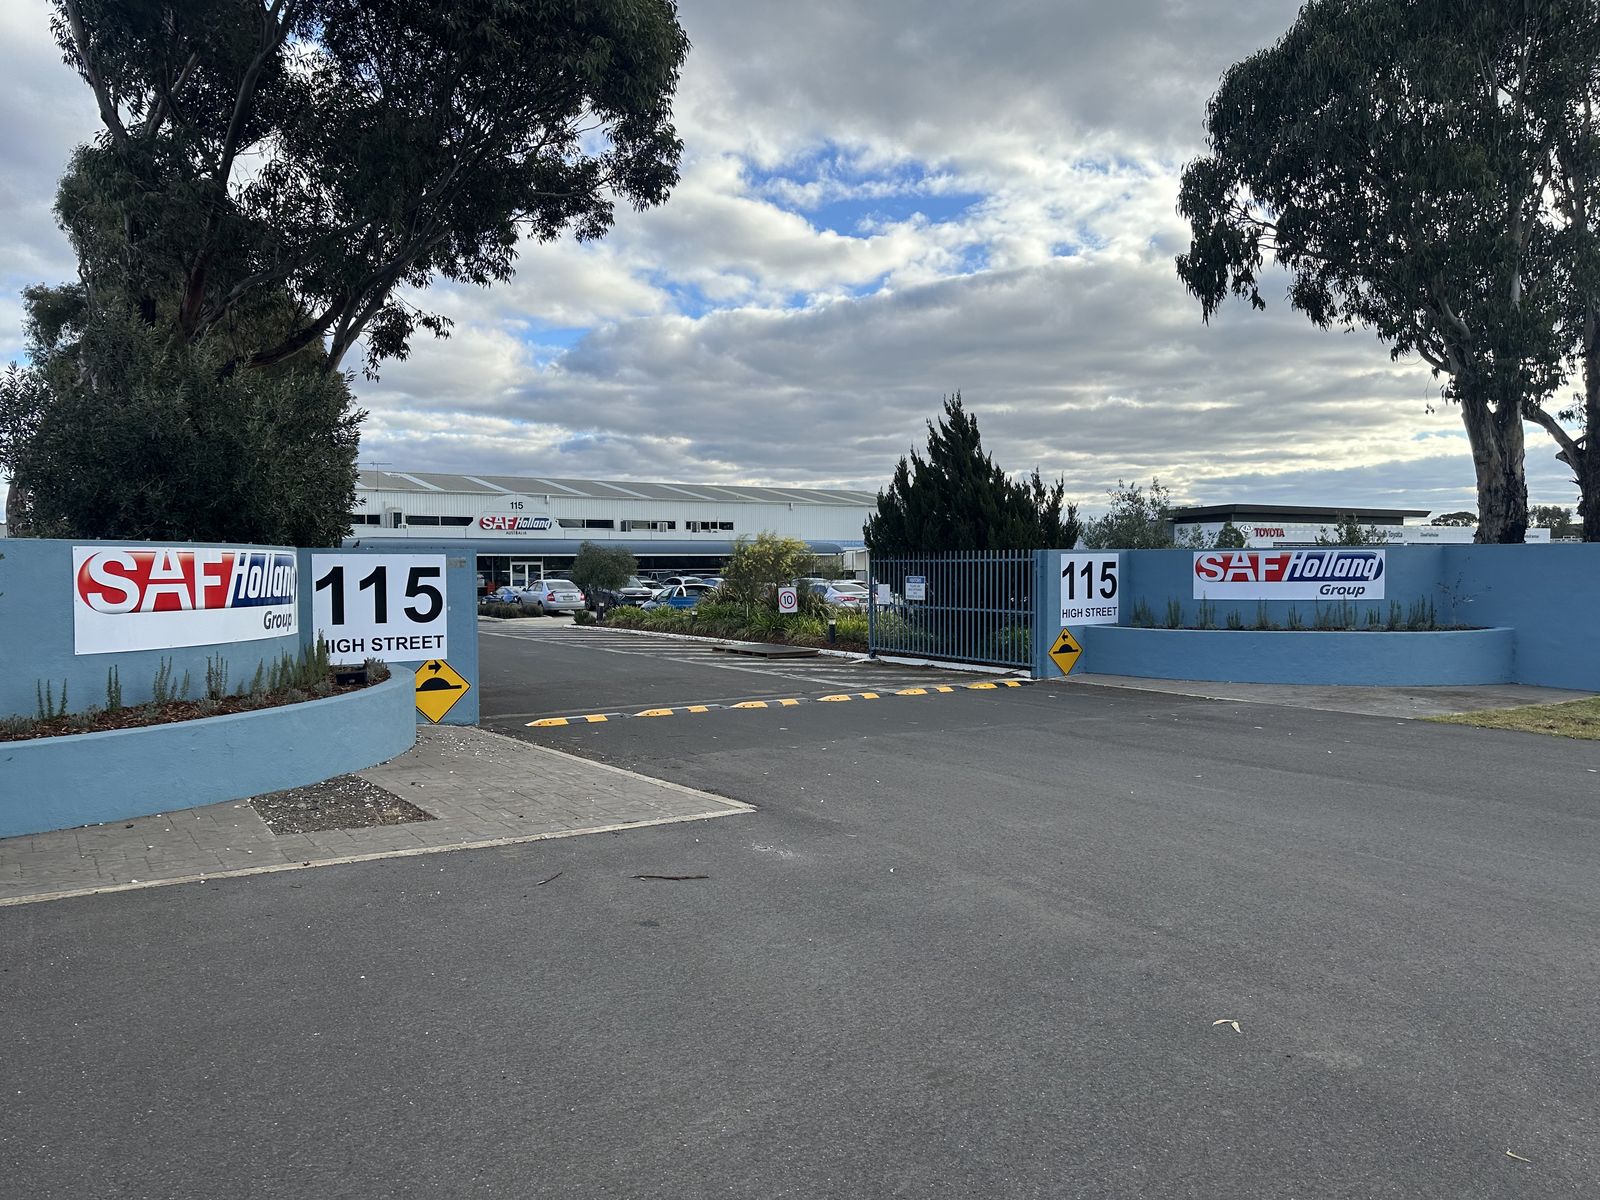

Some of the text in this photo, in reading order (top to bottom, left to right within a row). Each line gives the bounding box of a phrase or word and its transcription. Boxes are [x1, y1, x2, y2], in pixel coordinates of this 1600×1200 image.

[510, 501, 524, 510] 115
[482, 517, 552, 530] SAF Holland
[1254, 527, 1285, 537] TOYOTA
[1199, 552, 1380, 582] SAF Holland
[86, 550, 297, 614] SAF Holland
[1062, 561, 1117, 600] 115
[315, 566, 443, 625] 115
[1319, 584, 1366, 597] Group
[783, 595, 793, 605] 10
[1062, 606, 1117, 618] HIGH STREET
[263, 610, 292, 632] Group
[371, 635, 444, 651] STREET
